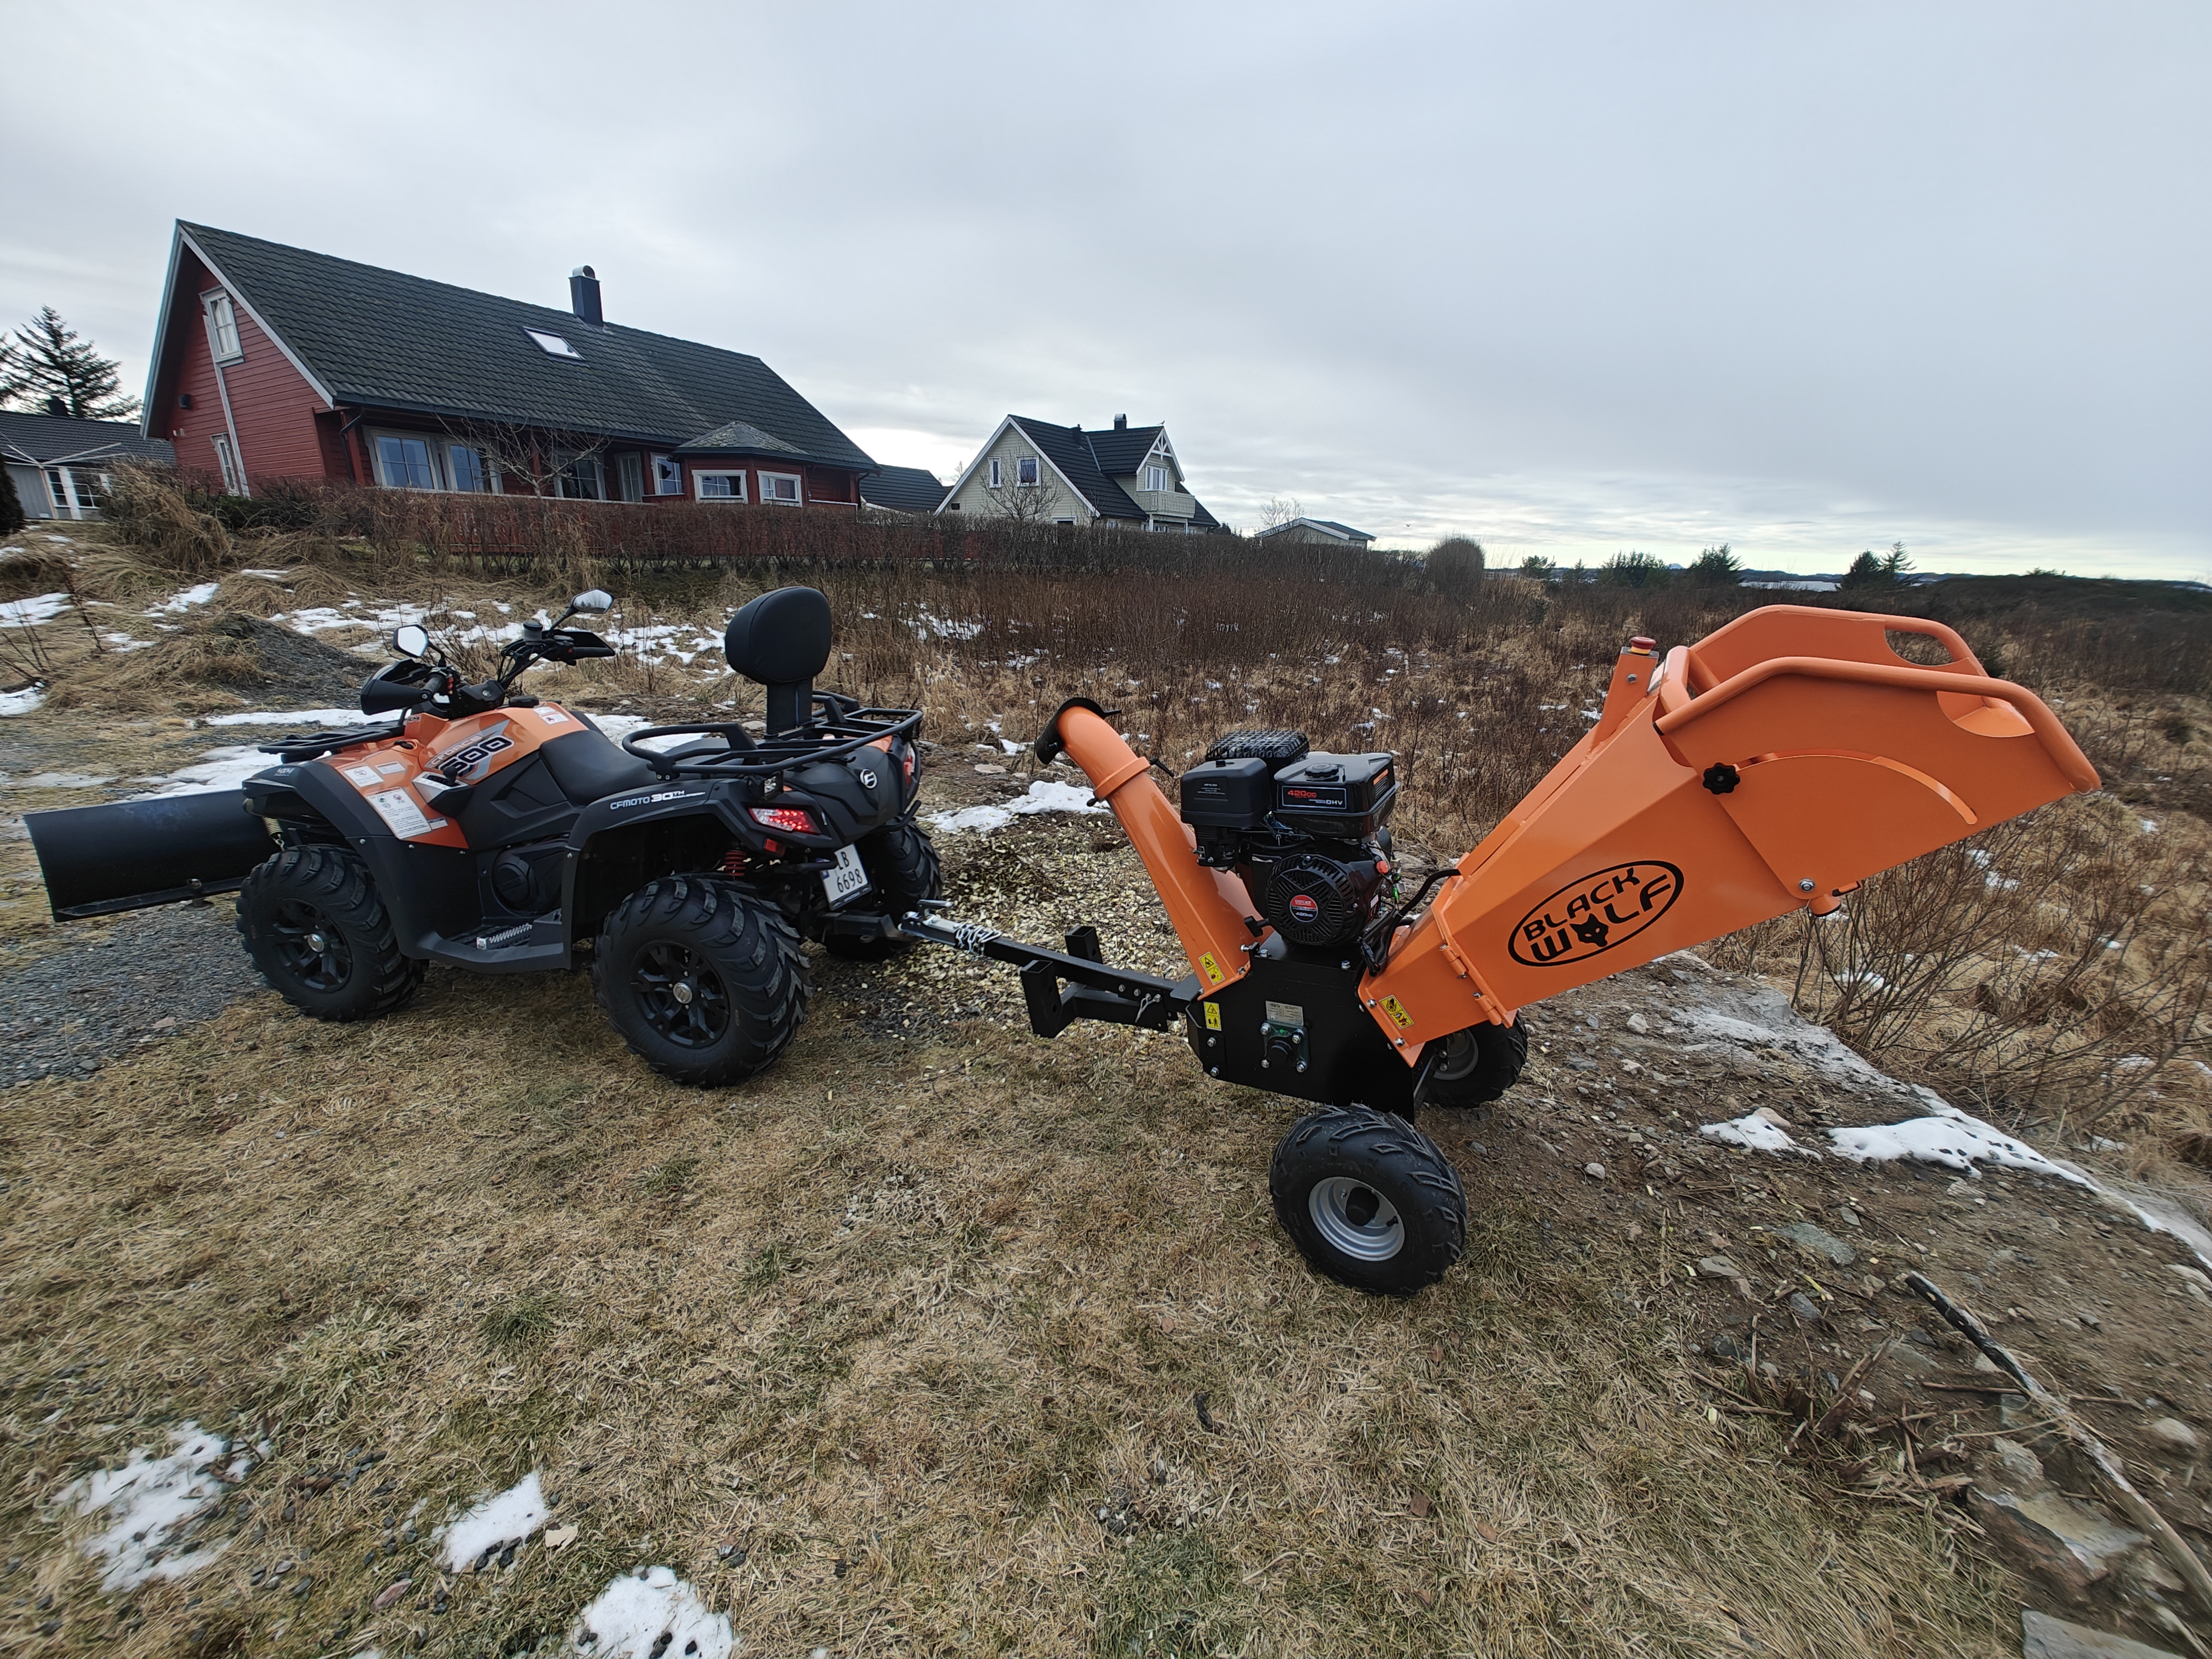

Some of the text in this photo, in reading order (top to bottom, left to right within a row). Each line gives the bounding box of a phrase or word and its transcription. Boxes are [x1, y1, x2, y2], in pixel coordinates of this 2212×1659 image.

[610, 796, 650, 810] CFMOTO
[837, 868, 862, 893] 6698
[1522, 867, 1640, 941] BLACK
